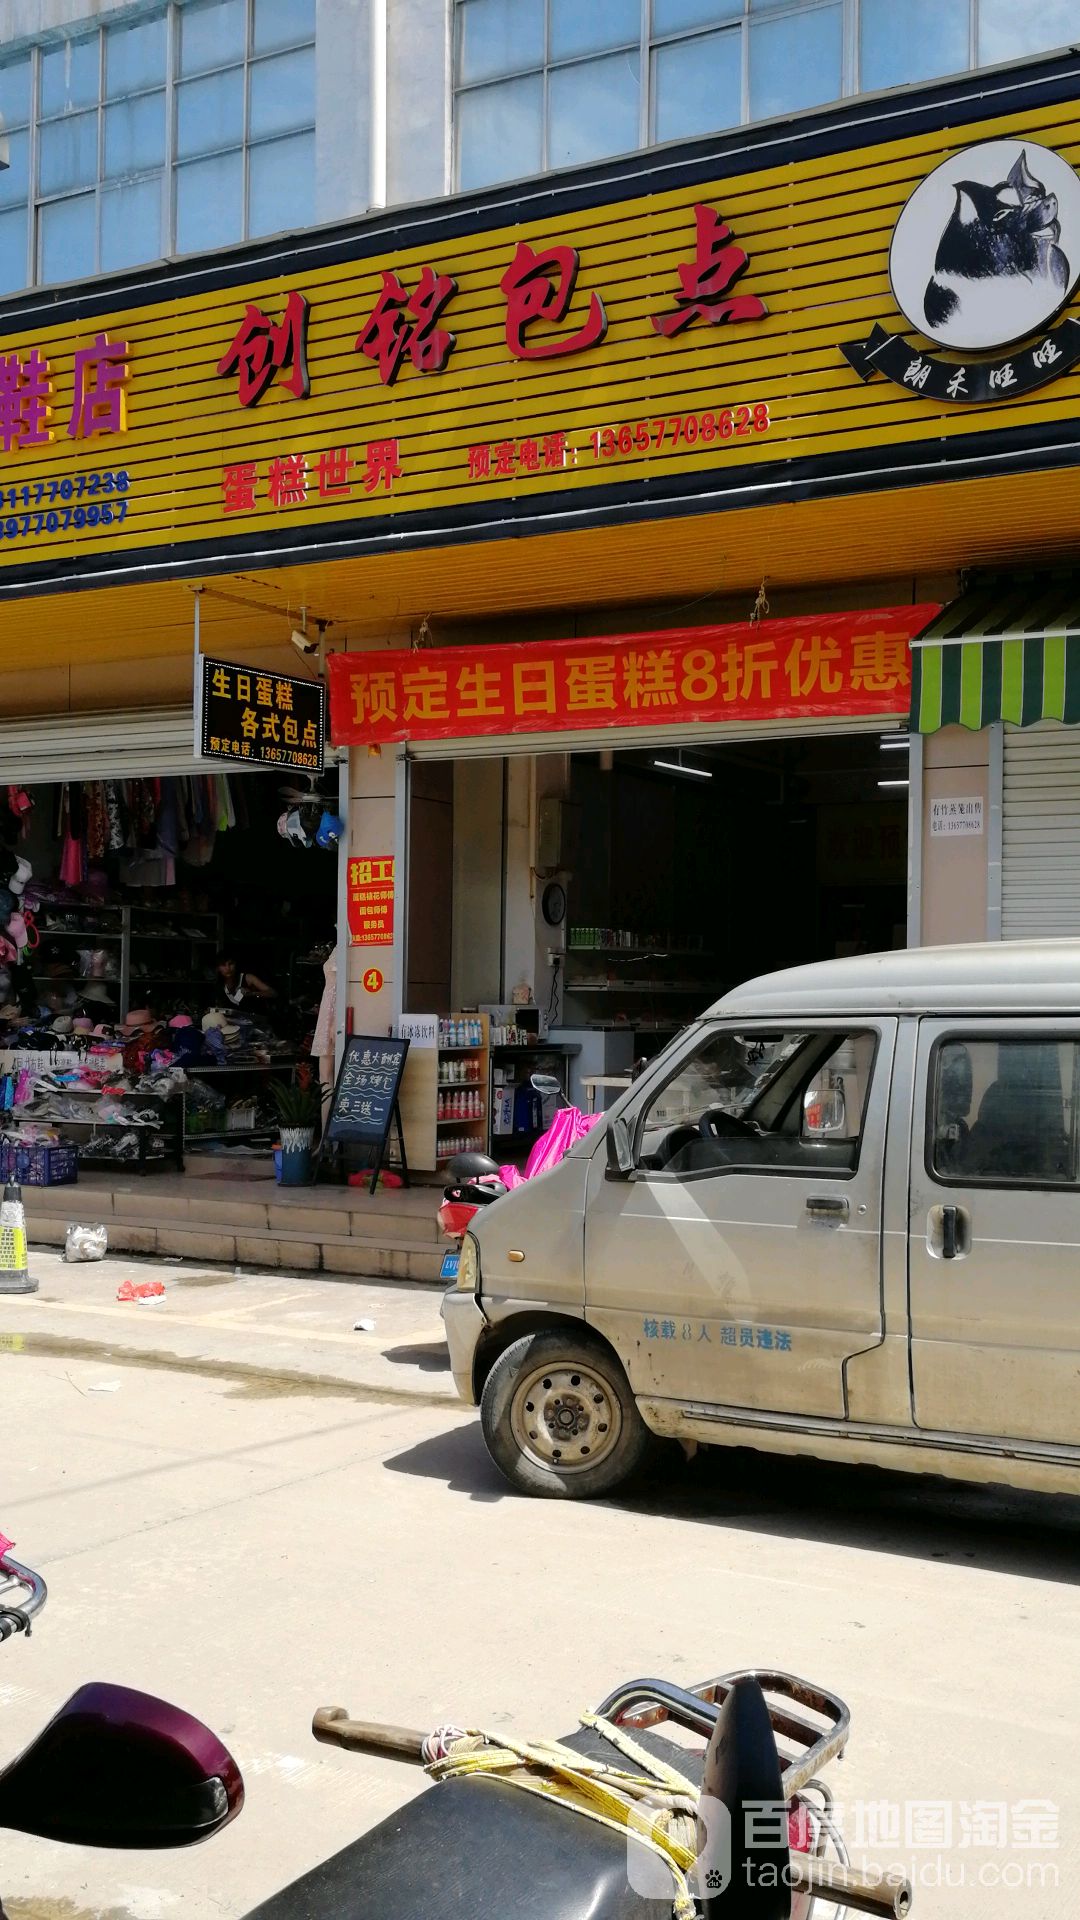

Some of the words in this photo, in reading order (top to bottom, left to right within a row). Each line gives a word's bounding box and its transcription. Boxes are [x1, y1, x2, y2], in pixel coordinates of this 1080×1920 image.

[217, 203, 769, 408] 创铭包点
[221, 439, 403, 514] 蛋糕世界
[212, 668, 293, 711] 生日蛋糕
[350, 631, 912, 726] 预定生日蛋糕8折优惠
[241, 707, 317, 748] 各式包点
[367, 972, 379, 990] 4
[720, 1326, 792, 1352] 超员违法
